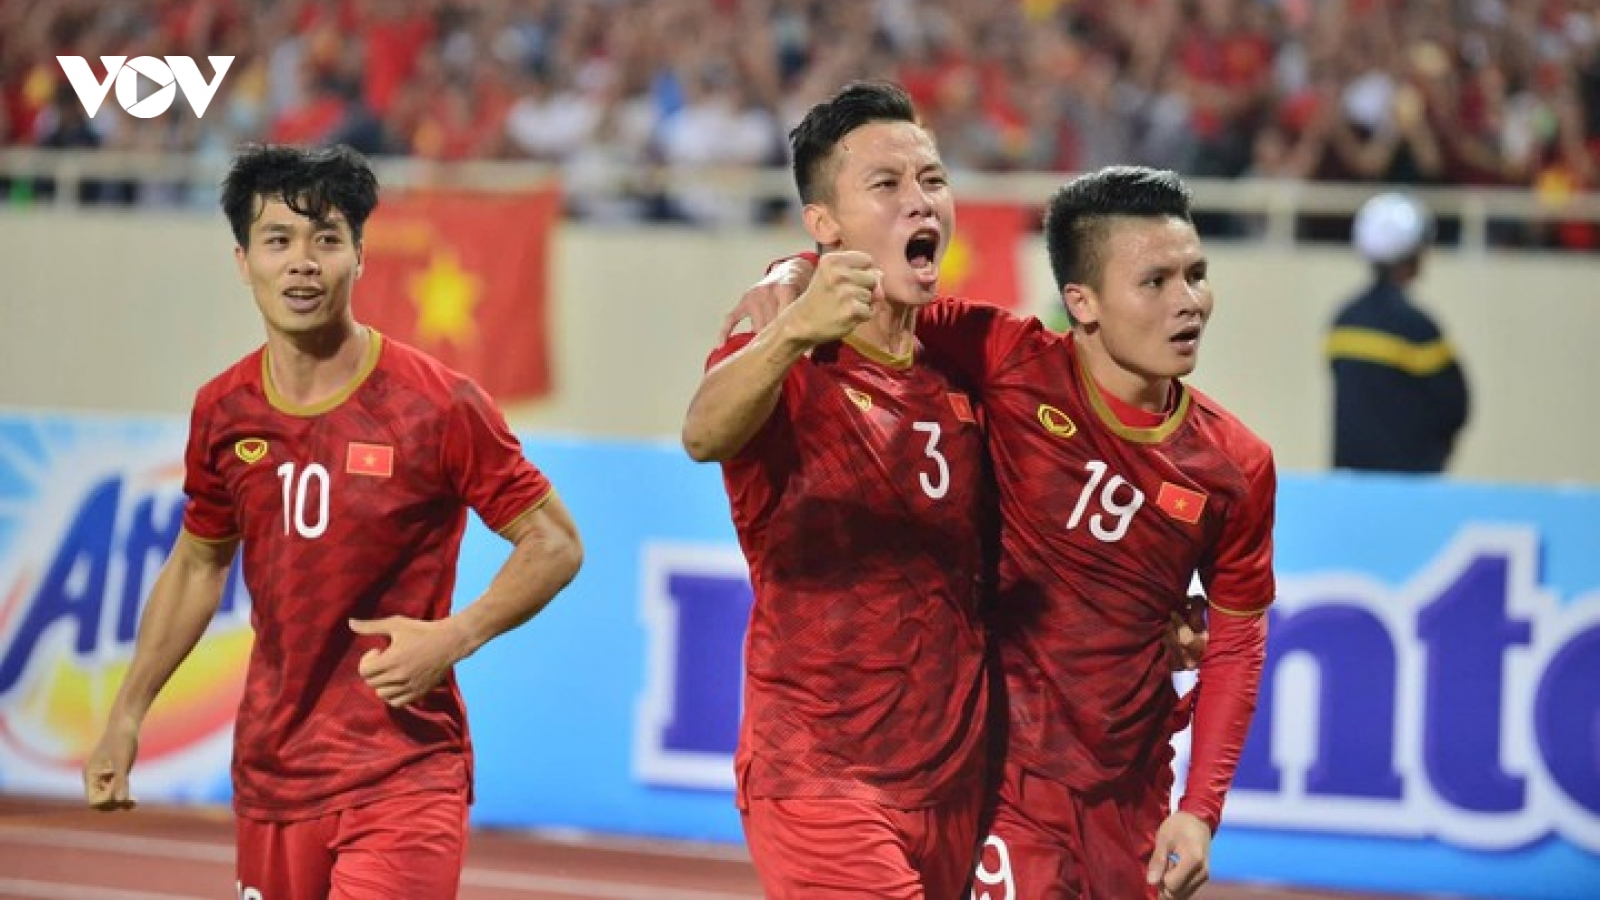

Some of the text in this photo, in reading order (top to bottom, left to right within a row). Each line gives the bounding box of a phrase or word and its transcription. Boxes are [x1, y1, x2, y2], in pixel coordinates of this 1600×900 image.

[913, 421, 950, 499] 3
[277, 462, 330, 539] 10
[1066, 460, 1145, 542] 19
